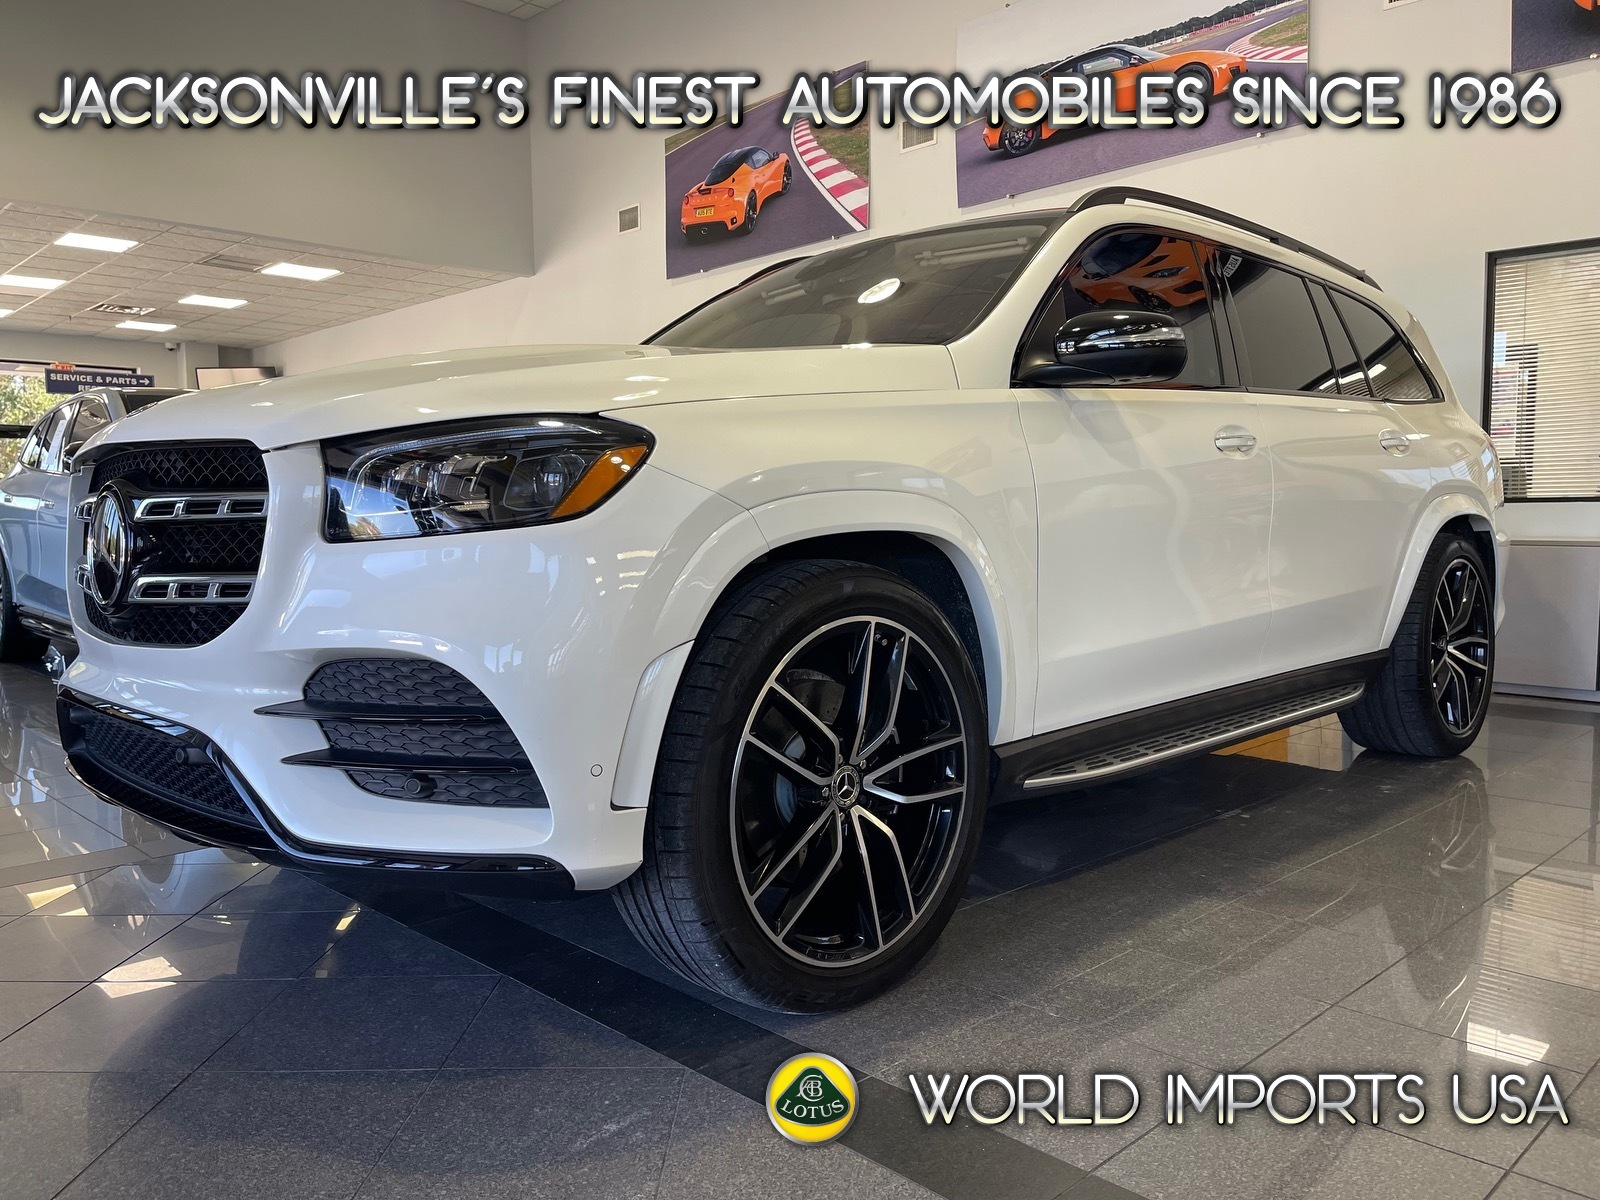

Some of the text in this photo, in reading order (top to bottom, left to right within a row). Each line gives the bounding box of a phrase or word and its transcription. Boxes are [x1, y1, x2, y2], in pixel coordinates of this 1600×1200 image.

[54, 363, 74, 371] EXIT
[50, 373, 93, 382] SERVICE
[105, 377, 137, 385] PARTS
